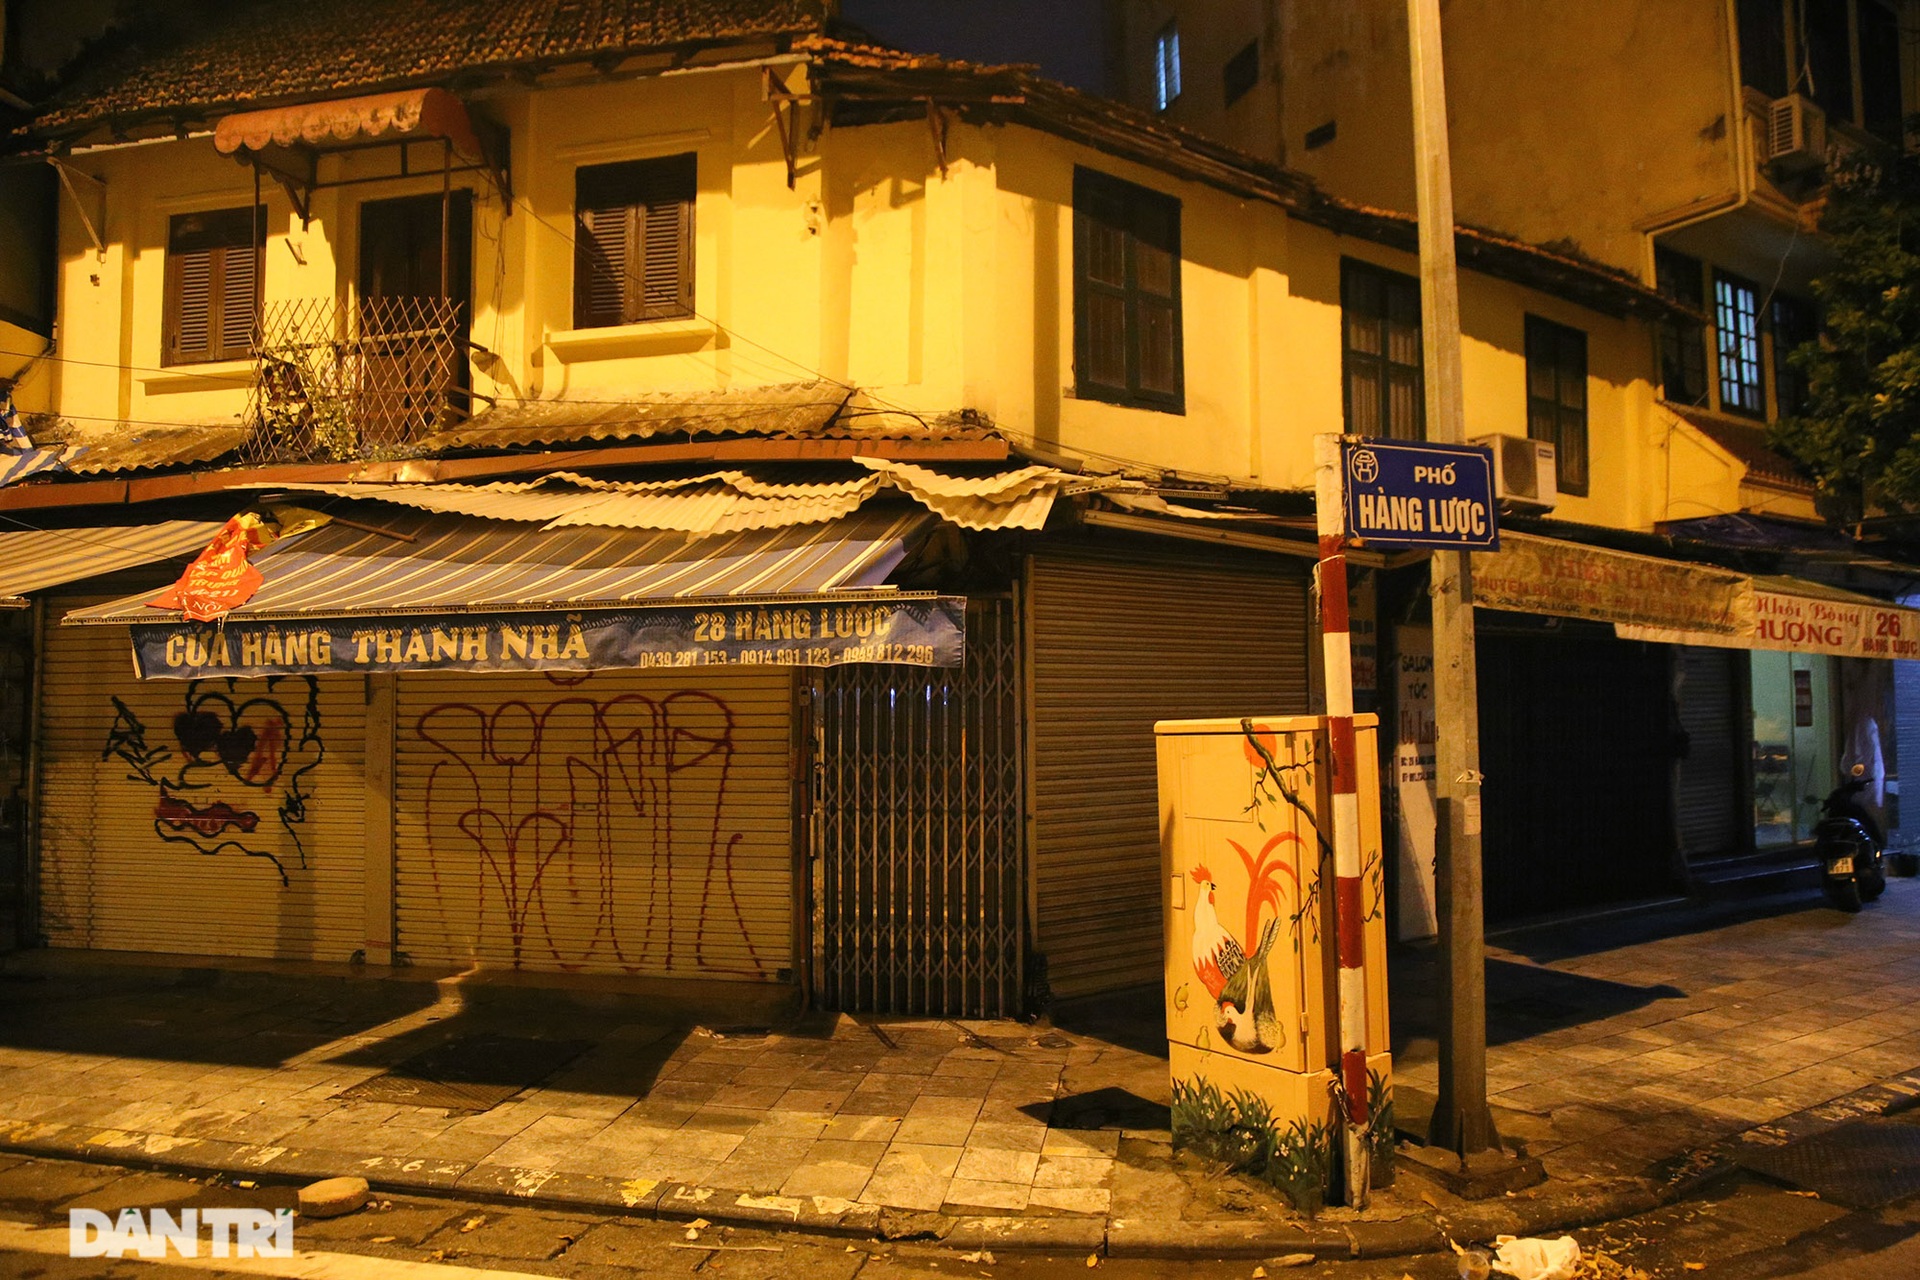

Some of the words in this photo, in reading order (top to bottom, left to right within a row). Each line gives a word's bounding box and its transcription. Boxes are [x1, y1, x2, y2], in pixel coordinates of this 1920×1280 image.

[1414, 461, 1456, 486] PHỐ
[1358, 486, 1424, 532] HÀNG
[1428, 496, 1486, 541] LƯỢC
[165, 622, 231, 667] CỬA
[242, 624, 332, 667] HÀNG
[351, 626, 488, 664] THANH
[500, 612, 590, 660] NHÃ
[694, 611, 727, 642] 28
[735, 604, 811, 641] HÀNG
[820, 603, 892, 644] LƯỢC
[1876, 612, 1901, 638] 26
[640, 651, 672, 668] 0439
[675, 650, 698, 667] 281
[703, 650, 728, 665] 153
[740, 649, 773, 665] 0914
[805, 647, 831, 666] 123
[876, 642, 903, 662] 812
[907, 644, 934, 664] 296
